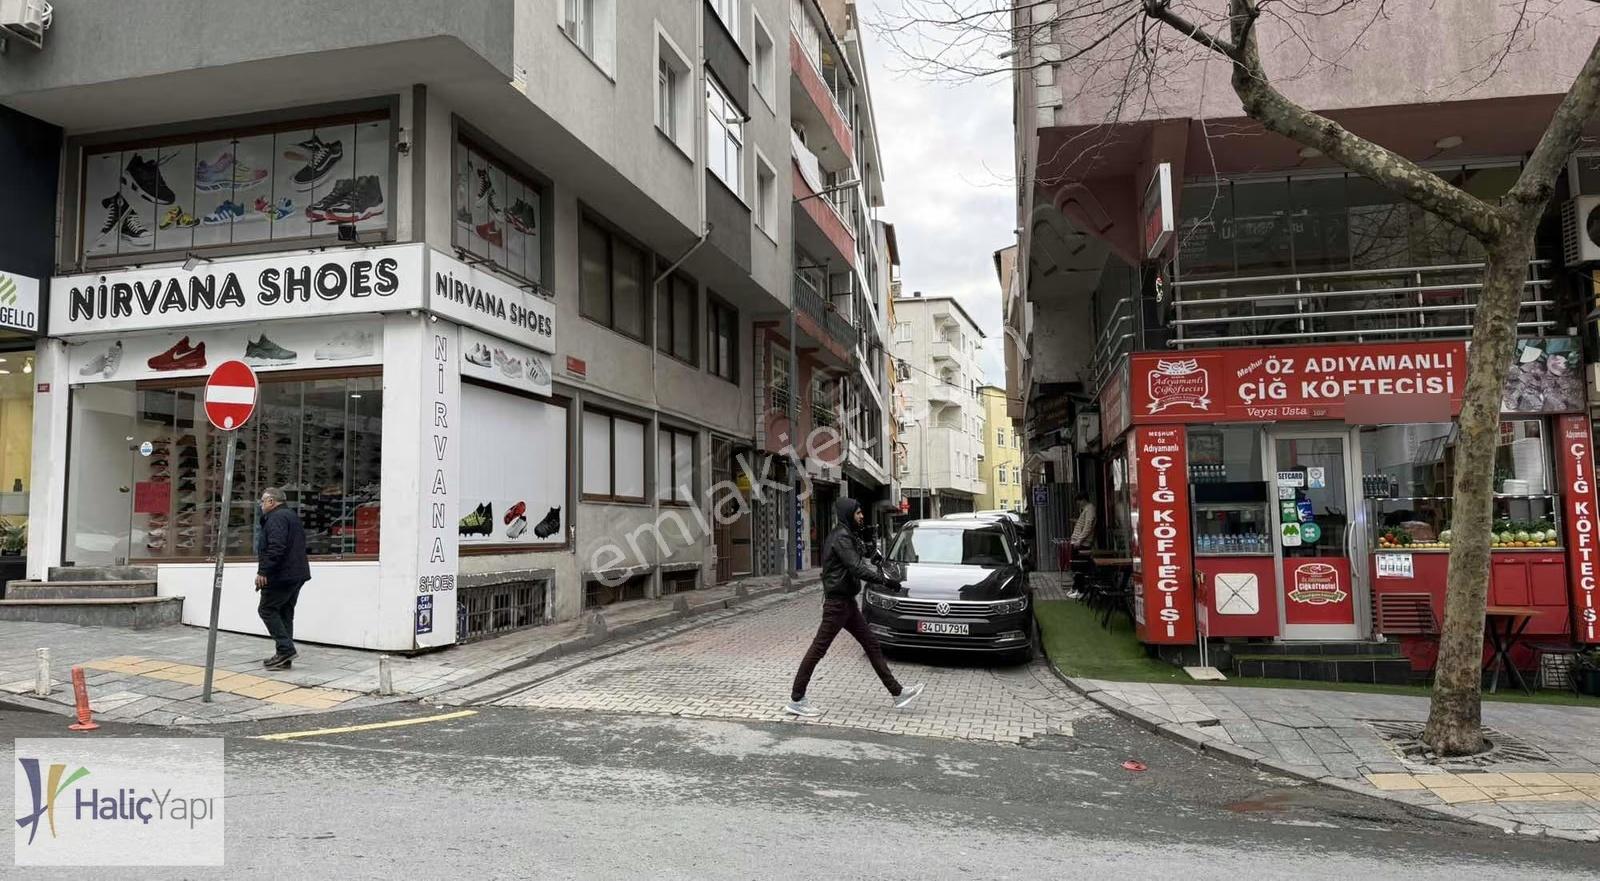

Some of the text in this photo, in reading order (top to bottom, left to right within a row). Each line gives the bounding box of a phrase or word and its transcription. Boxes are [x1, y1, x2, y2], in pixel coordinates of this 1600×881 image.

[69, 257, 399, 322] NİRVANA SHOES
[435, 271, 552, 338] NİRVANA SHOES
[1236, 353, 1453, 379] Meşhur ÖZ ADIYAMANLI
[1238, 371, 1454, 405] ÇİĞ KÖFTECİSİ
[1247, 407, 1277, 418] Veysi
[1281, 406, 1308, 416] Usta
[1151, 455, 1175, 503] ÇİĞ
[419, 575, 454, 592] SHOES
[1153, 509, 1180, 637] KÖFTECİSİ
[1575, 501, 1597, 639] KÖFTECİSİ
[922, 622, 968, 634] 34 DU 7914
